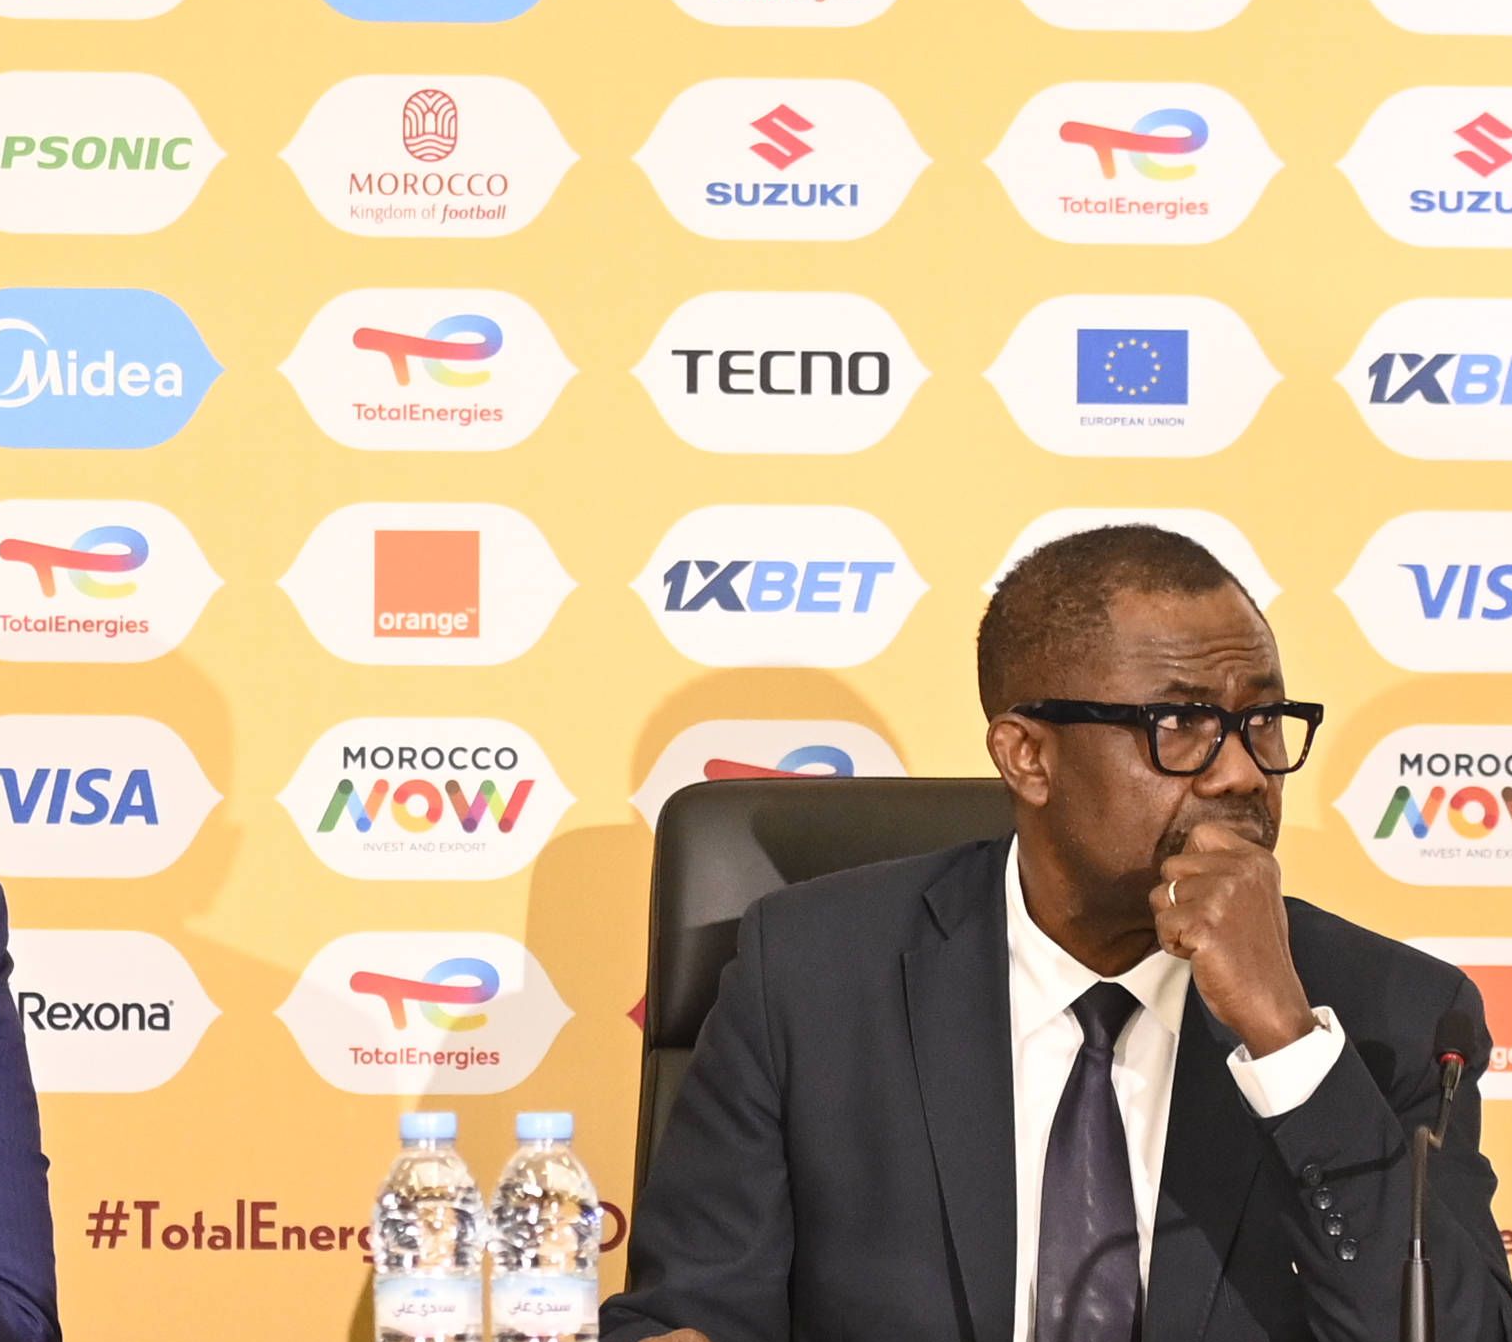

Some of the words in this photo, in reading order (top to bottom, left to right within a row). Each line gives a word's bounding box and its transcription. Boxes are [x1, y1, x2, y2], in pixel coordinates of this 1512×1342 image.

[350, 173, 508, 196] MOROCCO
[706, 183, 858, 206] SUZUKI
[350, 204, 416, 223] Kingdom
[420, 203, 437, 220] of
[441, 204, 506, 223] football
[13, 351, 184, 402] Midea
[672, 350, 889, 395] TECNO
[1080, 417, 1144, 426] EUROPEAN
[1147, 416, 1185, 427] UNION
[664, 560, 894, 612] 1XBET
[378, 609, 468, 634] orange
[344, 747, 518, 770] MOROCCO
[317, 779, 535, 833] NOW
[1419, 847, 1462, 860] INVEST
[1465, 848, 1493, 859] AND
[17, 992, 170, 1031] Rexona
